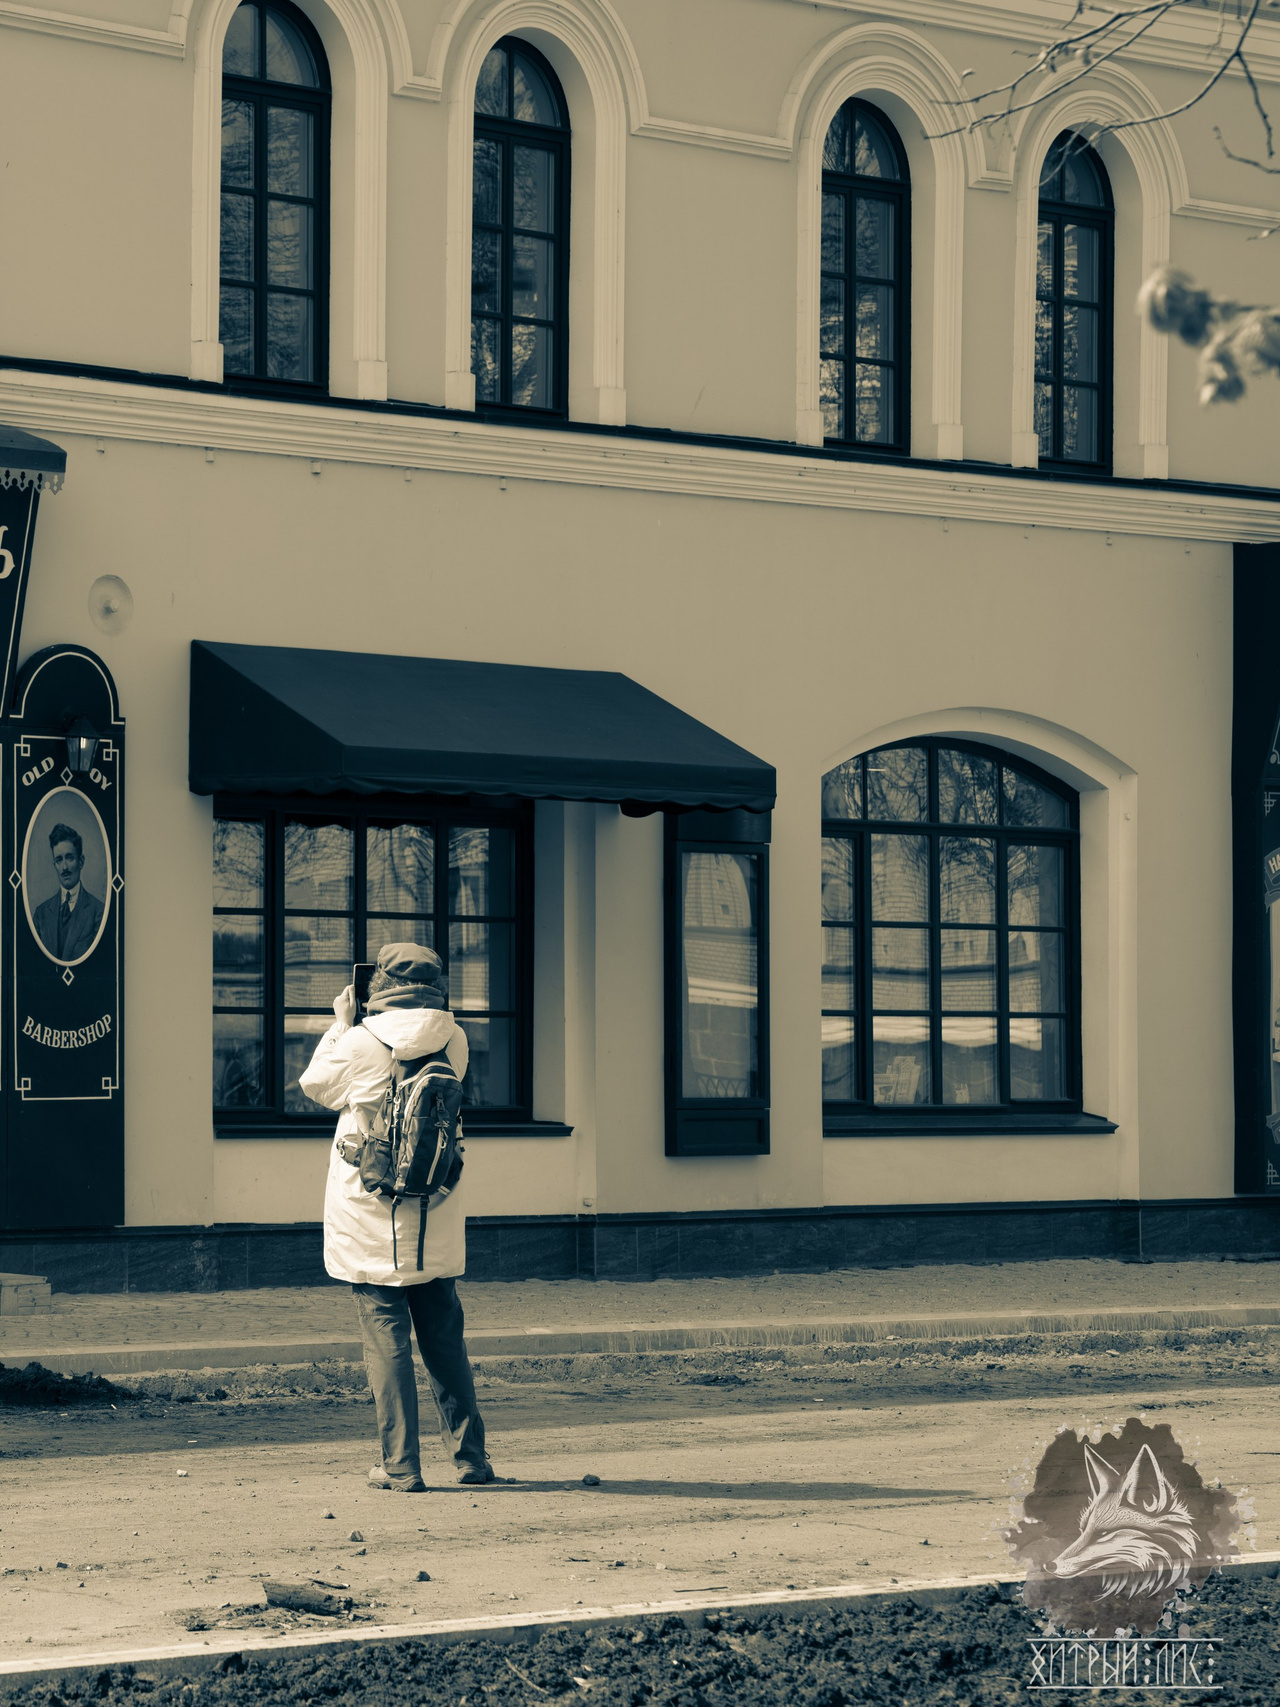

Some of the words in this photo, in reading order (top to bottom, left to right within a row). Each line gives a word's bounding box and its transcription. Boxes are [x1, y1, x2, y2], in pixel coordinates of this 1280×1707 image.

[22, 757, 55, 787] OLD
[89, 768, 113, 791] OY
[22, 1014, 112, 1048] BARBERSHOP
